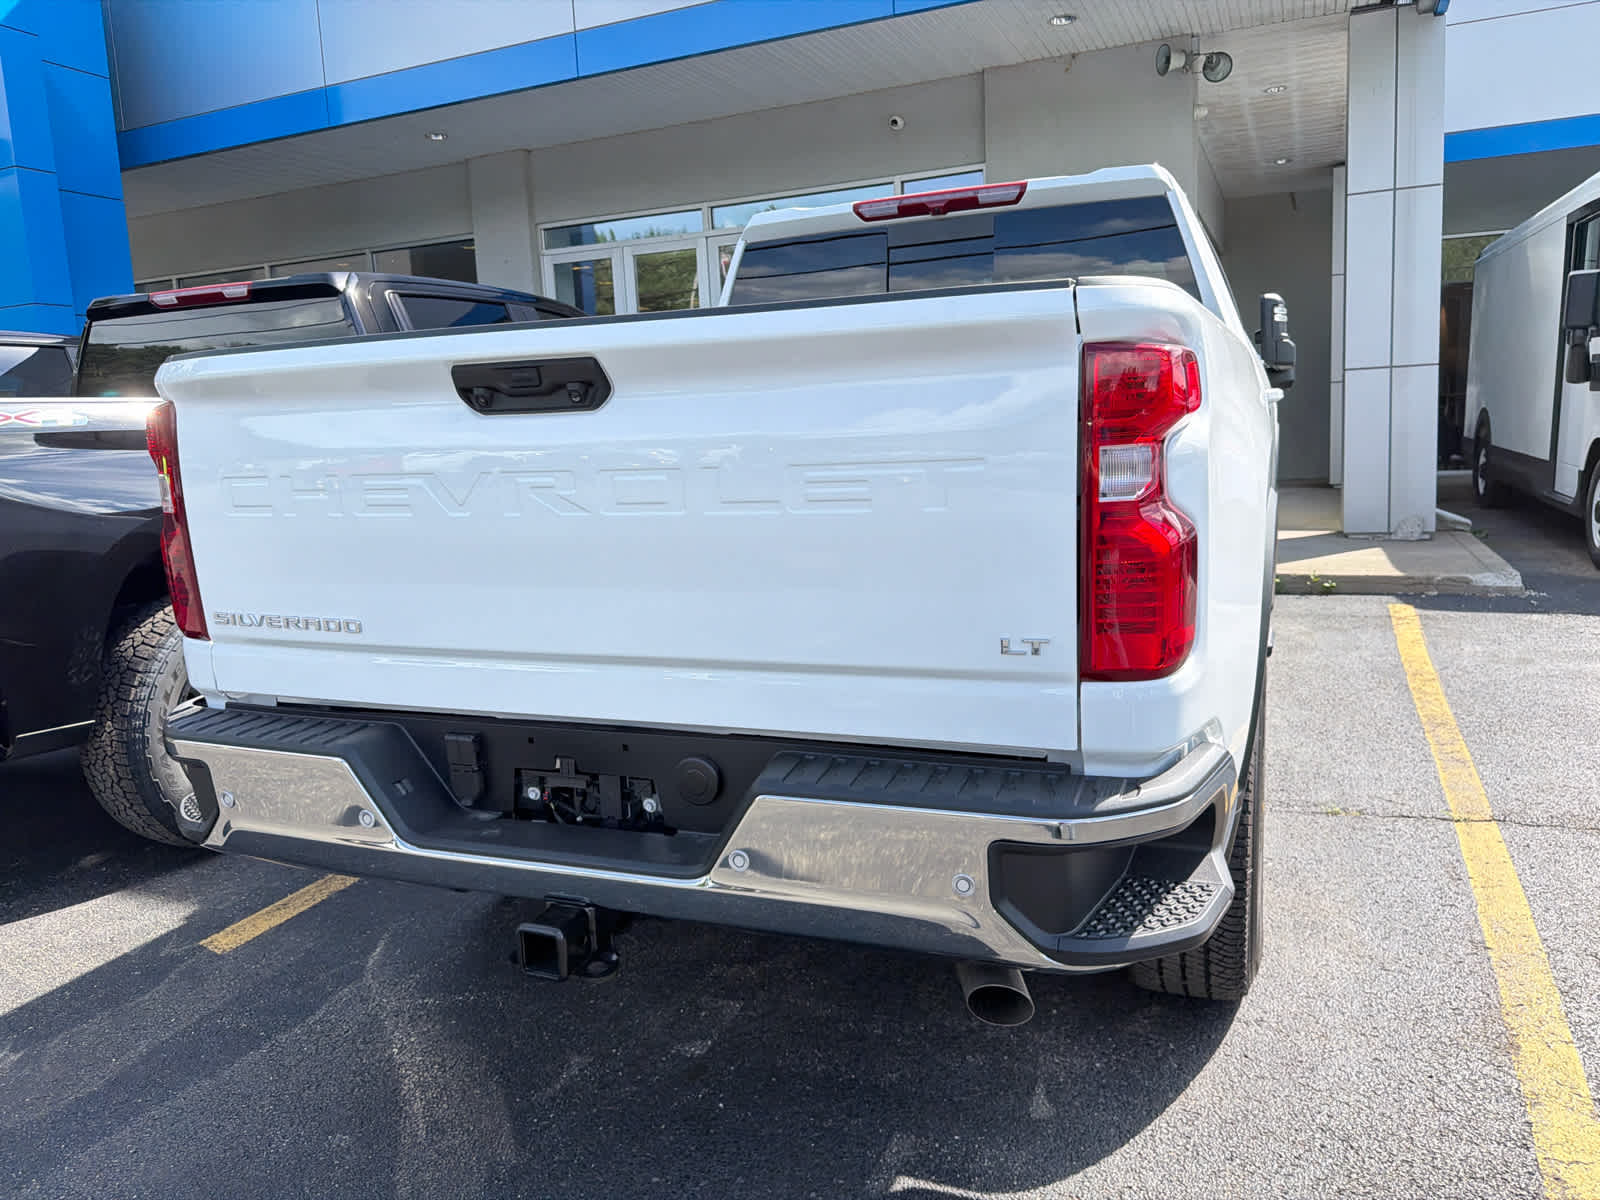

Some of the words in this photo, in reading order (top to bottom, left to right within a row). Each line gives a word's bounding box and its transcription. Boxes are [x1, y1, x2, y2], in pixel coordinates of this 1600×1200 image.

[220, 457, 985, 518] CHEVROLET
[214, 611, 363, 633] SILVERADO
[1000, 638, 1050, 656] LT
